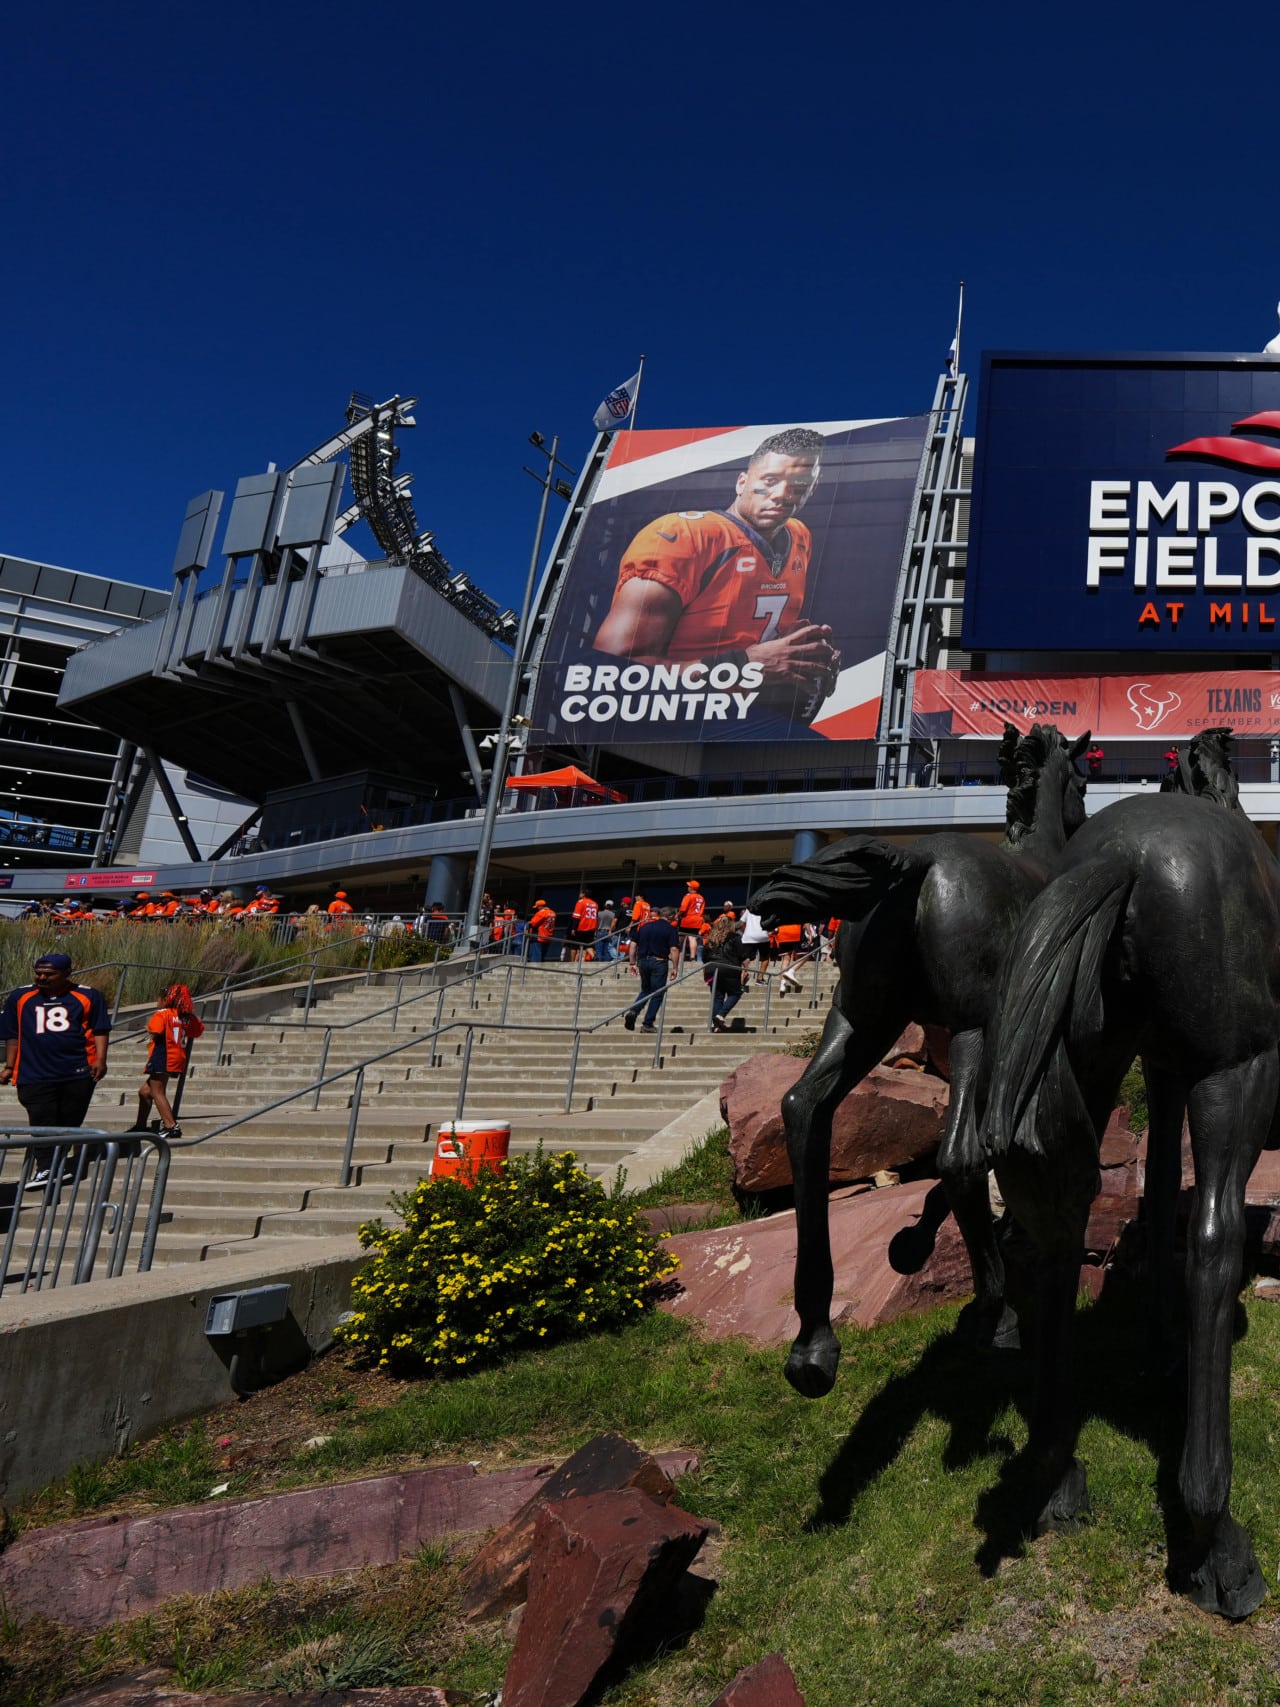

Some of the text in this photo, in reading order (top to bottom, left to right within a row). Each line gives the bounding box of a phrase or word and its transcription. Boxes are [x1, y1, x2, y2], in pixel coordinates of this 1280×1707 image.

[752, 593, 790, 644] 7
[1138, 602, 1185, 624] AT
[563, 661, 766, 692] BRONCOS
[560, 692, 761, 722] COUNTRY
[1207, 687, 1262, 714] TEXANS
[1186, 717, 1262, 727] SEPTEMBER
[34, 1005, 71, 1034] 18
